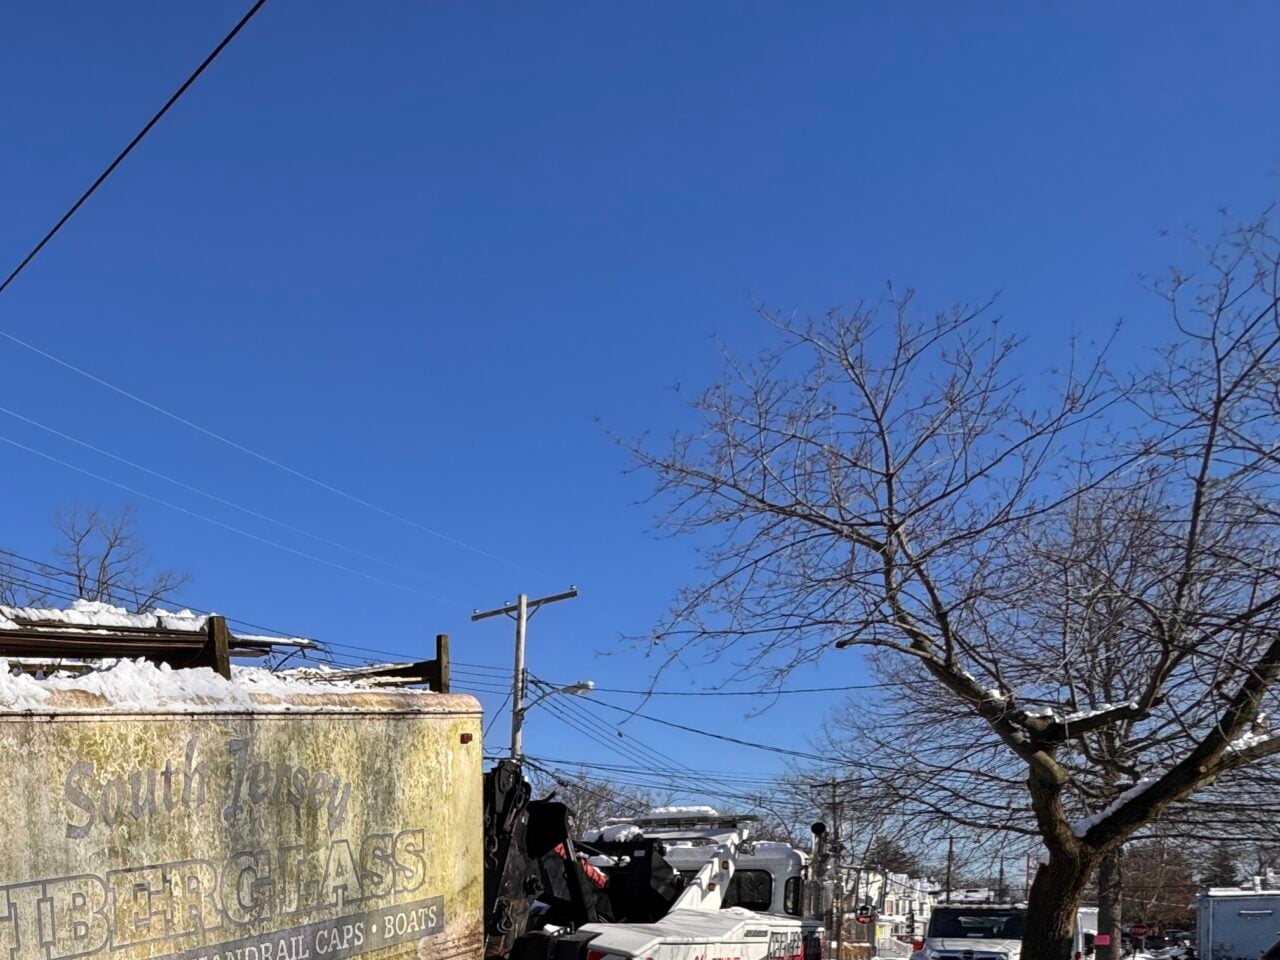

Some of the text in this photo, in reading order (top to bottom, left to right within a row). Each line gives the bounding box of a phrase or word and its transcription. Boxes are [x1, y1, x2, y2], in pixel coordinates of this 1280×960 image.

[65, 735, 352, 840] South Jersey
[315, 922, 364, 955] CAPS
[383, 904, 438, 940] BOATS
